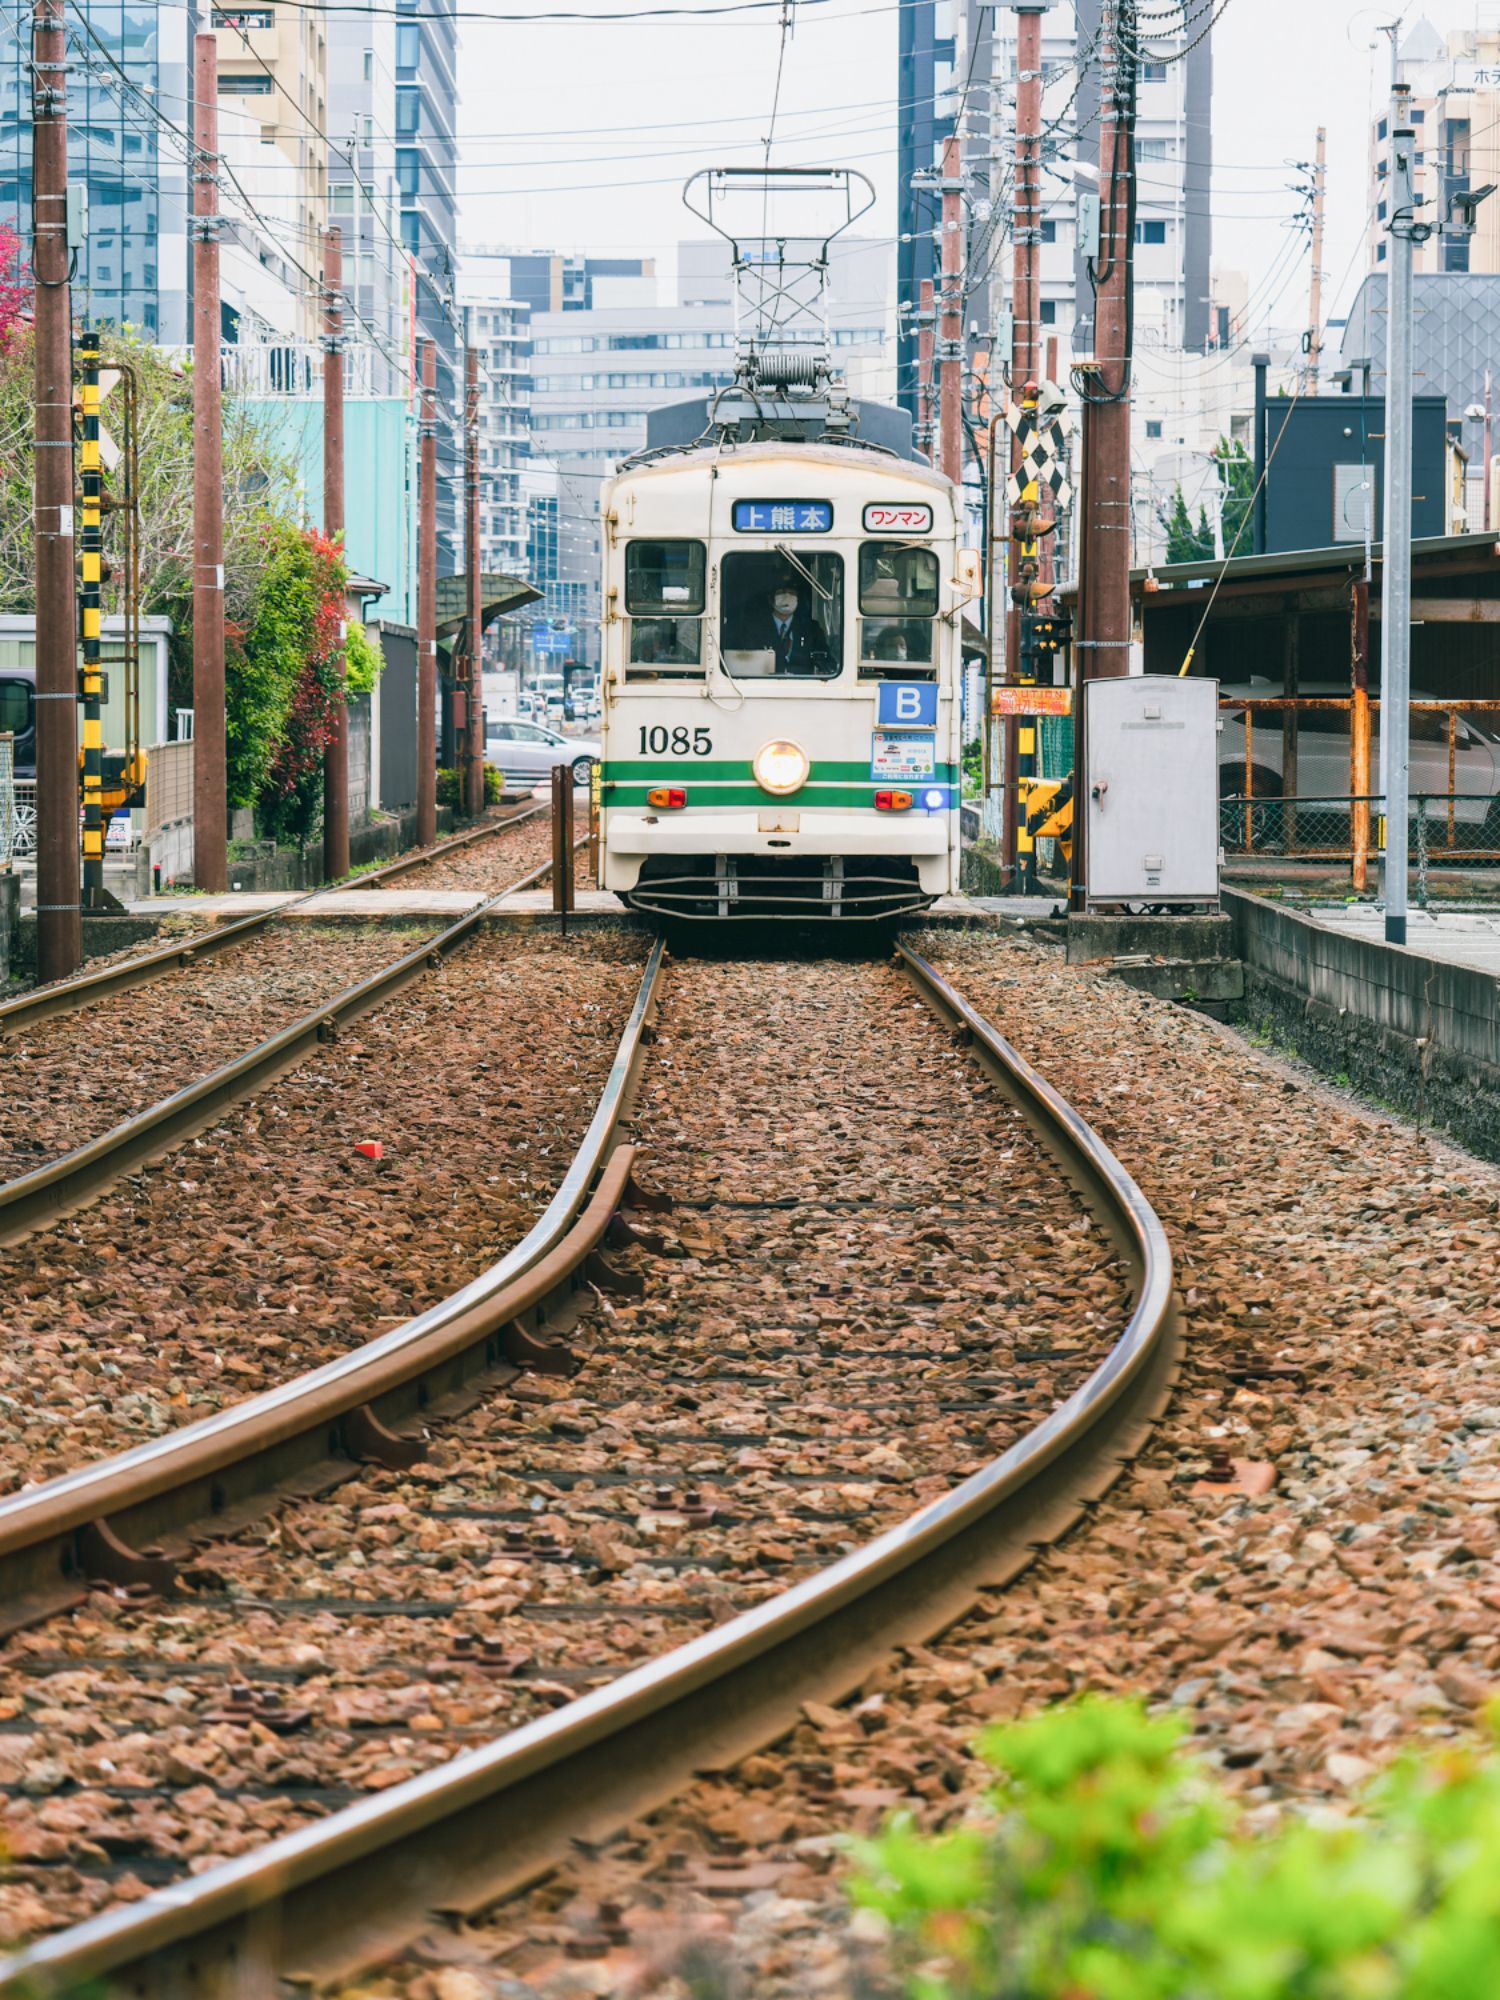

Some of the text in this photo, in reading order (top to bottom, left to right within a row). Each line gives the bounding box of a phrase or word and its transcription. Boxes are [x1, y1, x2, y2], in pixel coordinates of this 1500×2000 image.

[741, 505, 826, 531] 上熊本
[871, 511, 926, 525] ワンマン
[896, 687, 921, 719] B
[1000, 689, 1063, 699] CAUTION
[639, 725, 713, 756] 1085
